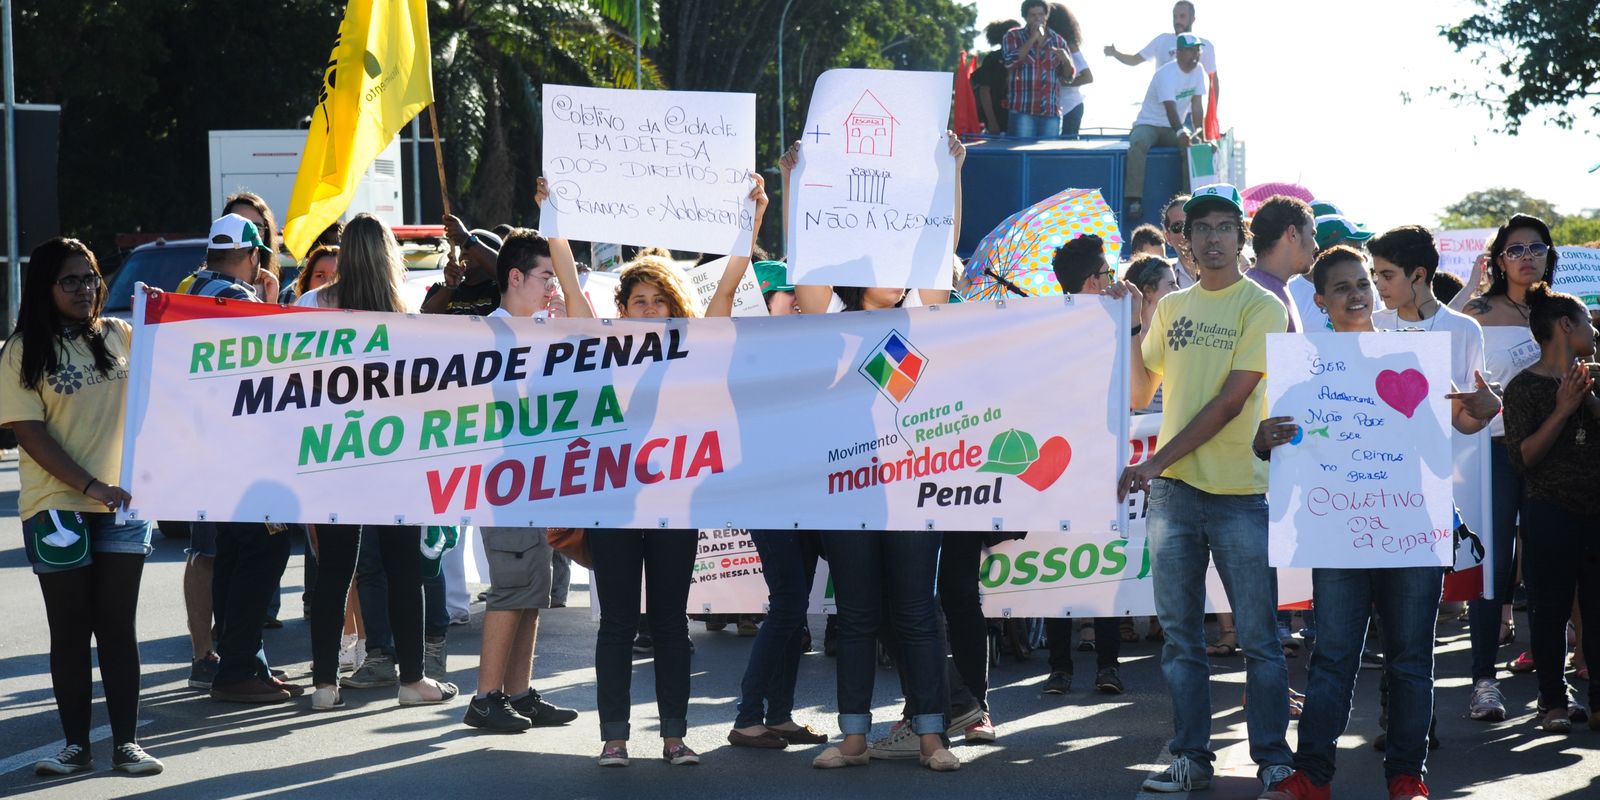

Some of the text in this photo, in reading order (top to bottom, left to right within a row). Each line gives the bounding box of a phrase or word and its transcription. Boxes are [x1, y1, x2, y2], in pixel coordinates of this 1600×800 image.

[552, 95, 625, 131] Coletivo
[578, 132, 711, 163] EM DEFESA
[551, 156, 608, 174] DOS
[1561, 251, 1593, 260] CONTRA
[189, 324, 390, 374] REDUZIR A
[1205, 334, 1234, 350] Cena
[232, 329, 689, 417] MAIORIDADE PENAL
[1310, 357, 1346, 375] SER
[297, 384, 624, 466] NÃO REDUZ A
[902, 400, 963, 428] Contra a
[915, 407, 1002, 443] Redução da
[828, 433, 898, 463] Movimento
[426, 430, 724, 515] VIOLÊNCIA
[828, 440, 983, 494] maioridade
[917, 477, 1003, 508] Penal
[720, 568, 750, 579] NESSA
[980, 540, 1129, 588] OSSOS
